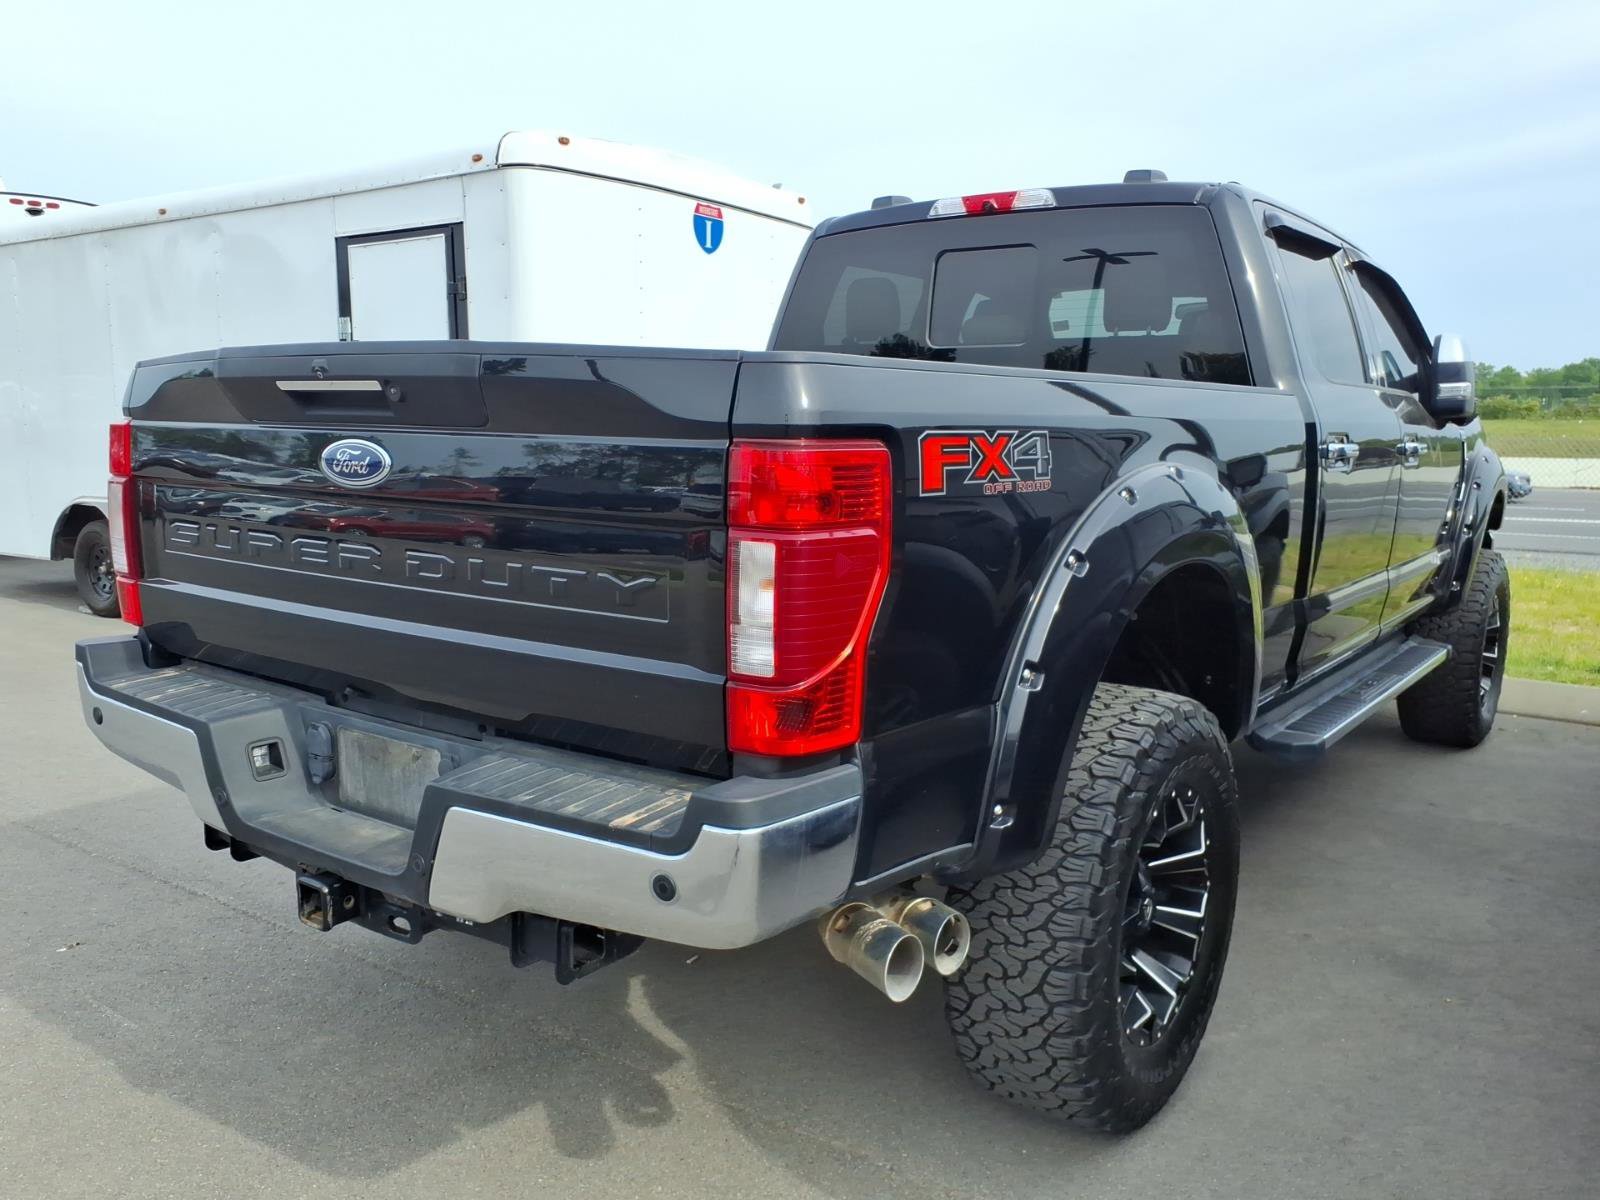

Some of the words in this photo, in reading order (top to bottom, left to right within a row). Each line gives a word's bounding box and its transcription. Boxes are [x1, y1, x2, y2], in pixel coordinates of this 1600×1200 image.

[704, 220, 713, 248] I
[333, 448, 371, 474] Ford
[918, 430, 1052, 497] FX4
[984, 482, 1013, 495] OFF
[1016, 480, 1052, 493] ROAD
[170, 520, 382, 571] SUPER
[405, 549, 657, 606] DUTY
